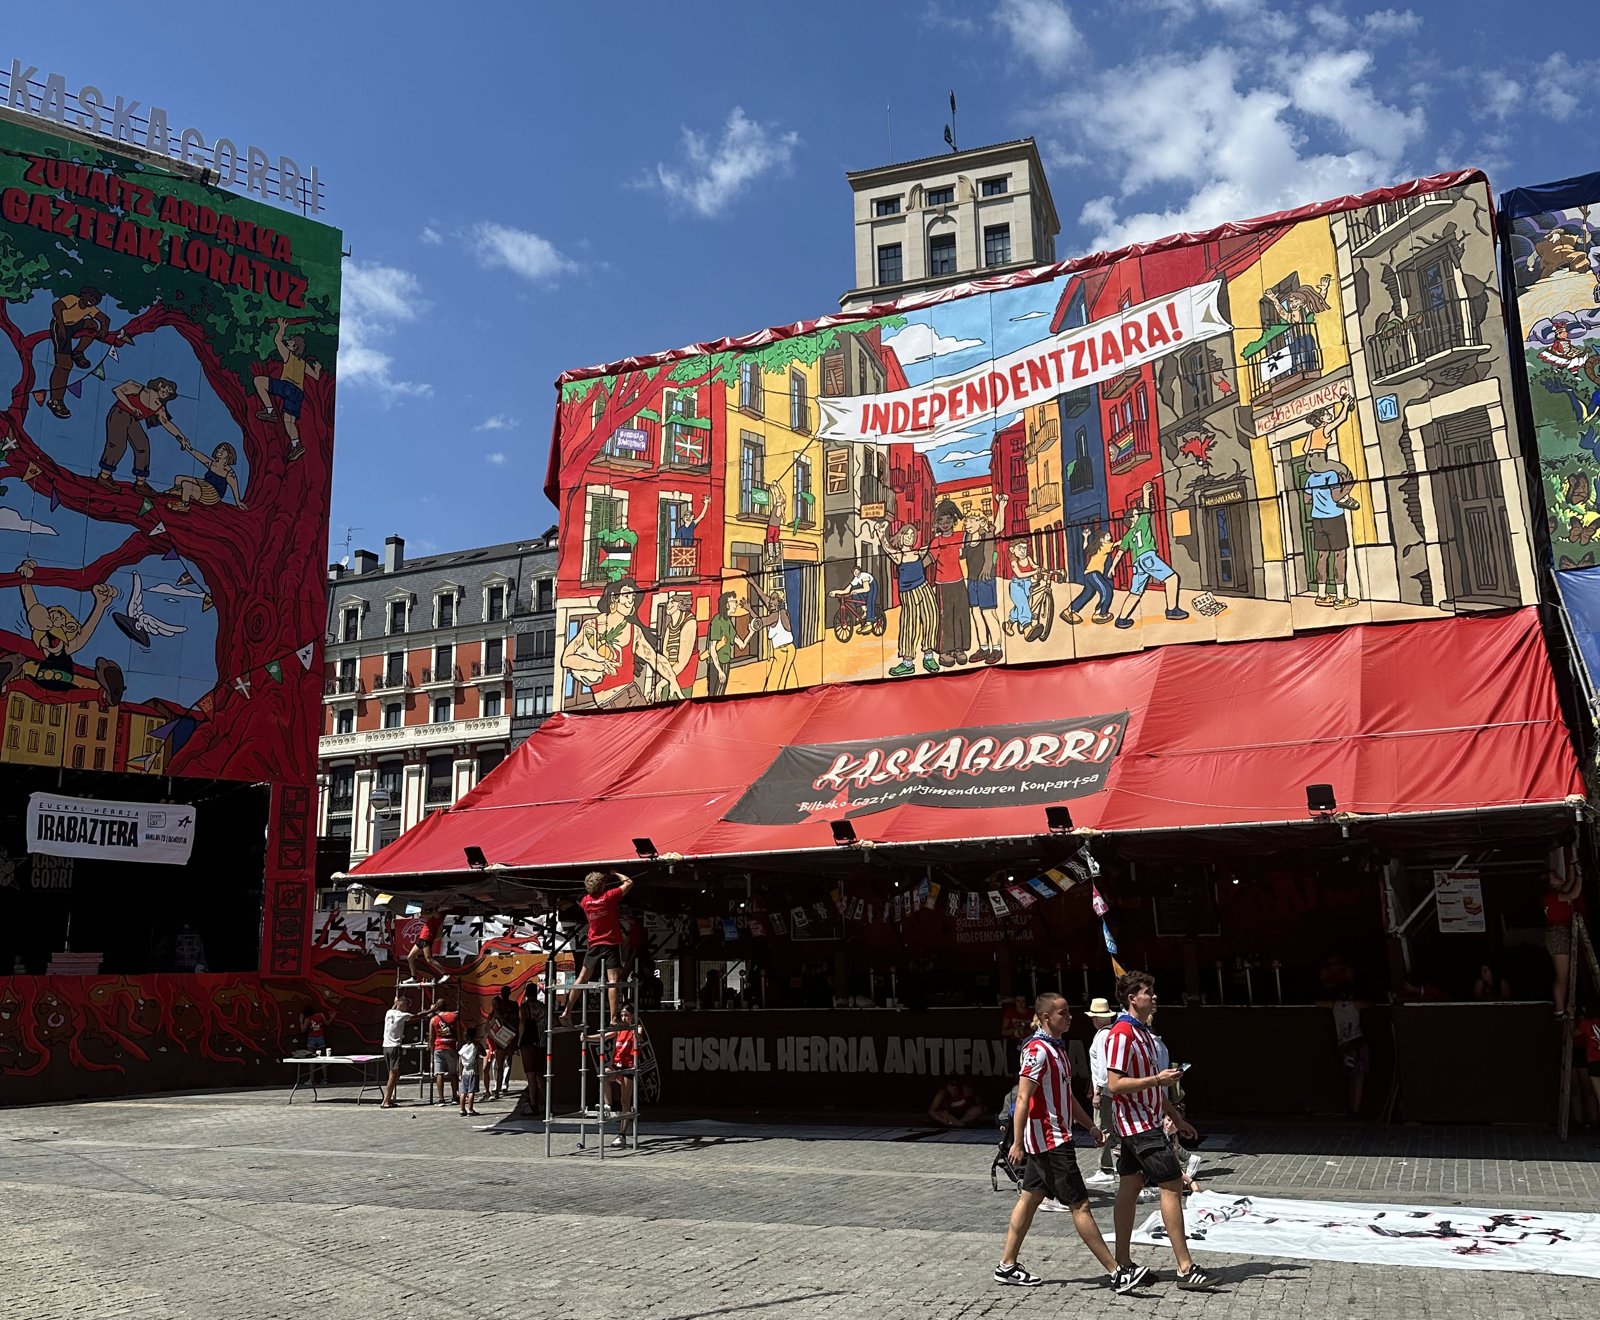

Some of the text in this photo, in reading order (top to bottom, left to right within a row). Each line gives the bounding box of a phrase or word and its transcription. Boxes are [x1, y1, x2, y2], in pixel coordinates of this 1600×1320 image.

[5, 58, 320, 215] KASKAGORRI
[23, 154, 294, 264] ZUHAITZ ARDAXKA
[1, 186, 308, 308] GAZTEAK LORATUZ
[860, 303, 1182, 434] INDEPENDENTZIARA!
[39, 802, 140, 817] EUSKAL HERRIA
[799, 773, 1099, 813] Bilboko Gazte Mugimenduaren Konpartsa
[37, 814, 139, 847] IRABAZTERA
[31, 868, 74, 889] GORRI
[672, 1036, 1090, 1078] EUSKAL HERRIA ANTIFAXA
